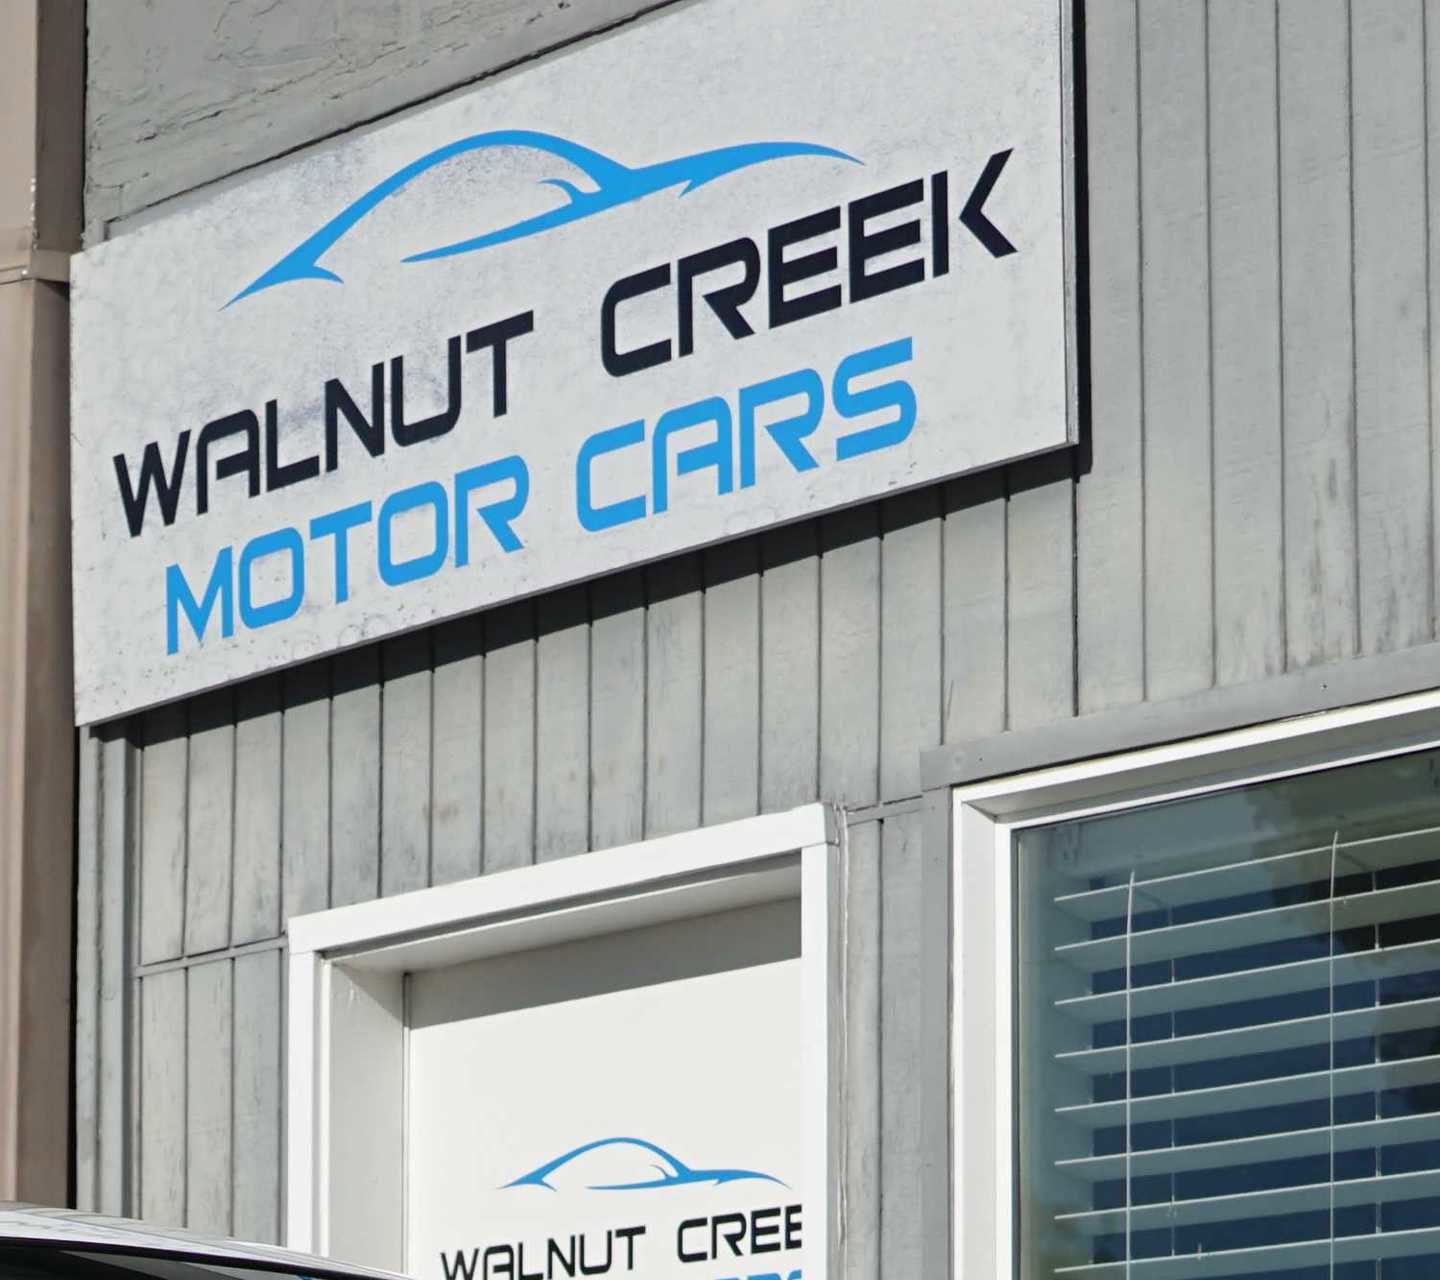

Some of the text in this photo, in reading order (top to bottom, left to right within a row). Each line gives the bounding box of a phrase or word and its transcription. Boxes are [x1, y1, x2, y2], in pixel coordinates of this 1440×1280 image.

[113, 148, 1018, 538] WALNUT CREEK
[165, 336, 918, 657] MOTOR CARS
